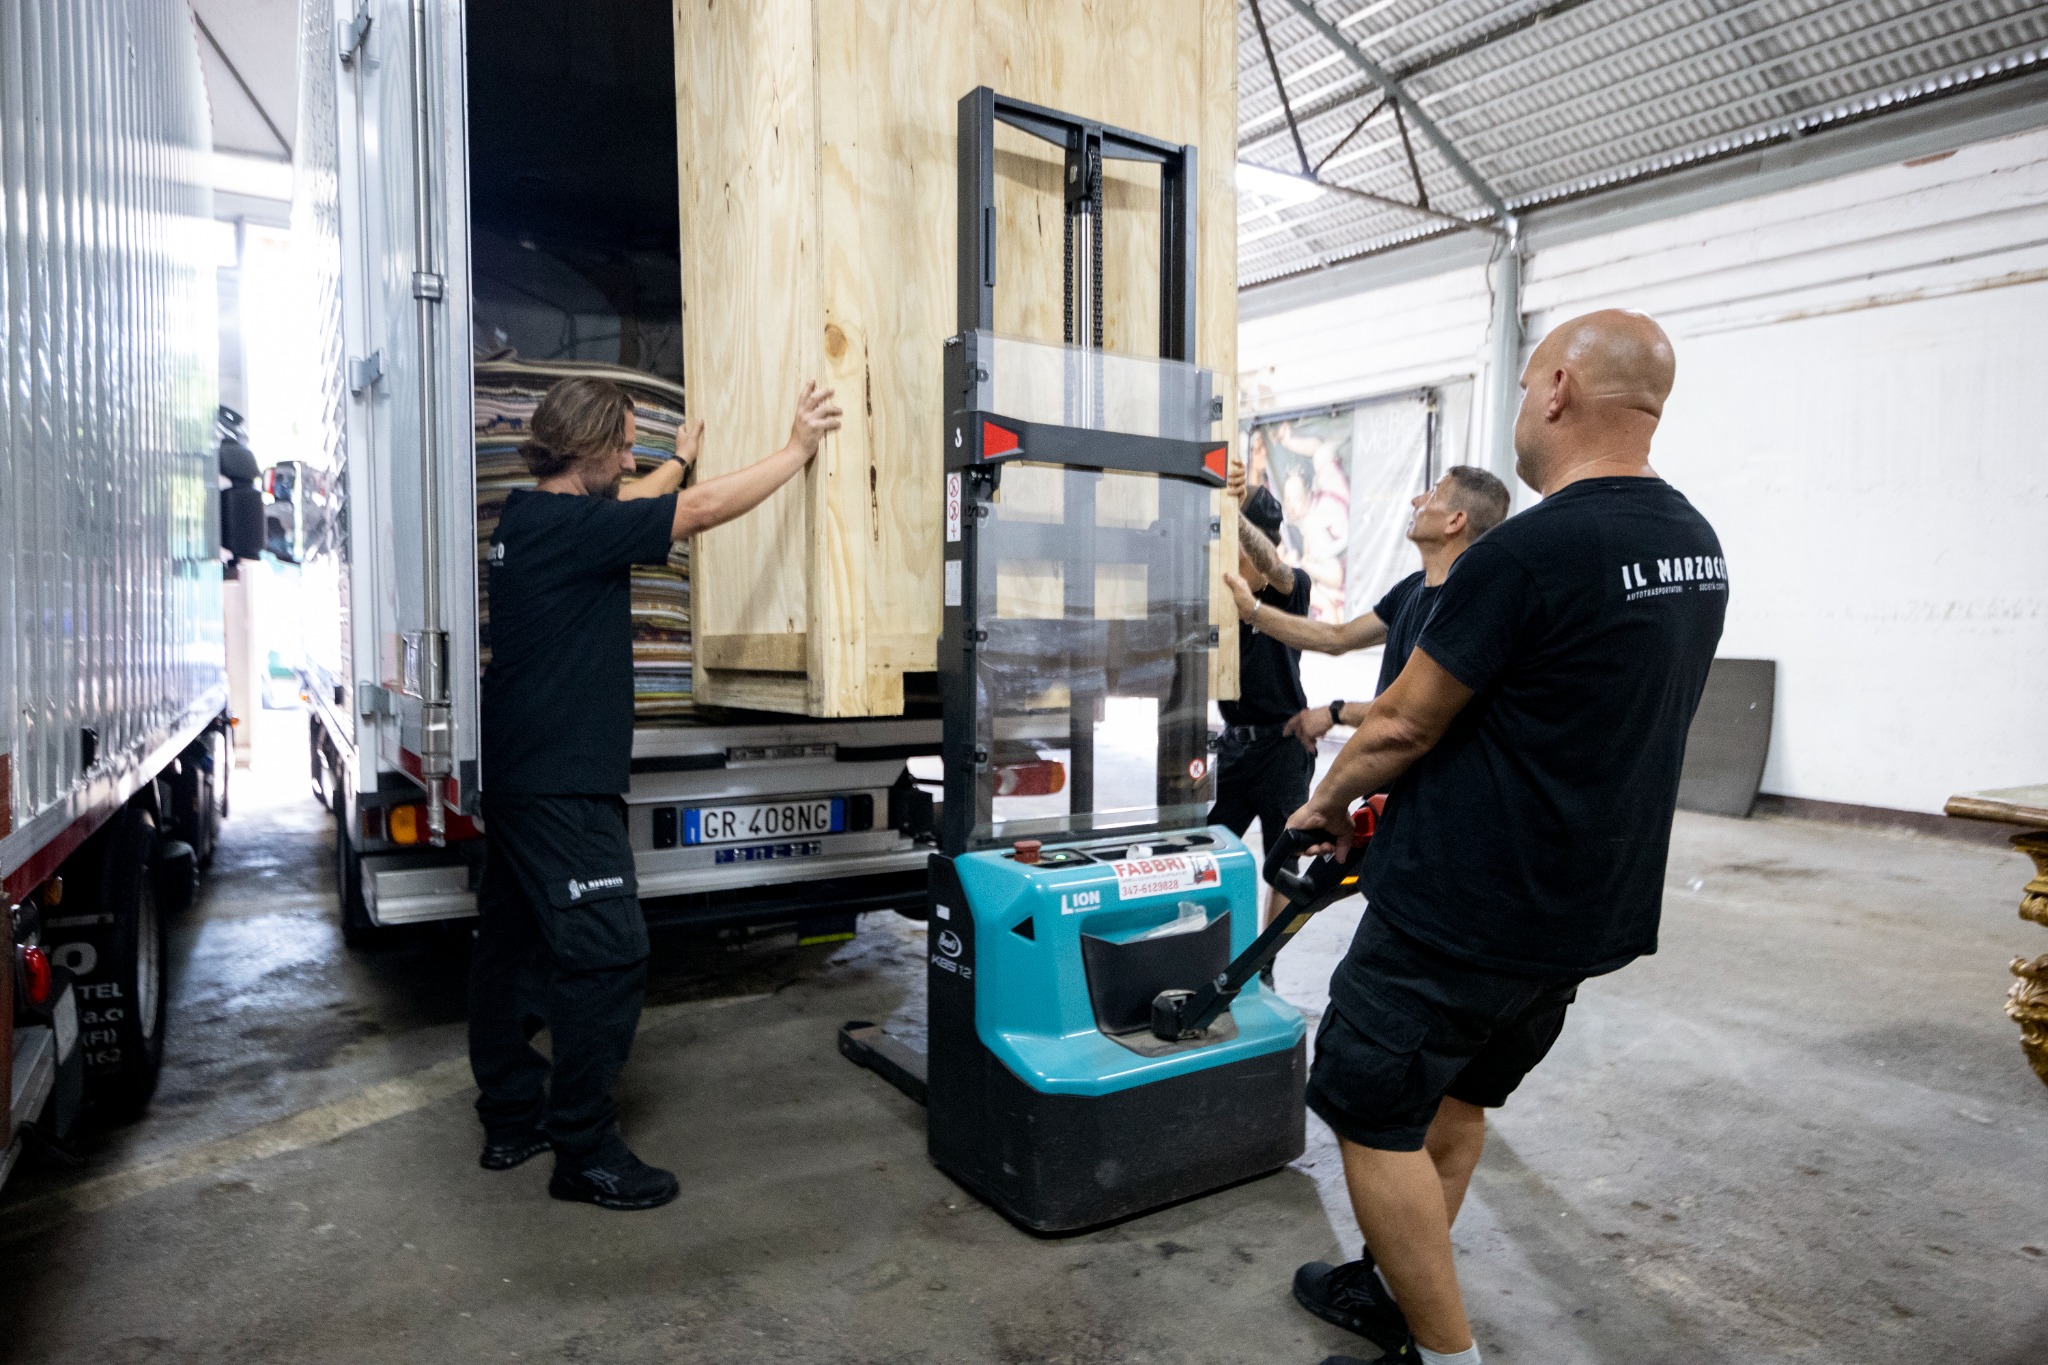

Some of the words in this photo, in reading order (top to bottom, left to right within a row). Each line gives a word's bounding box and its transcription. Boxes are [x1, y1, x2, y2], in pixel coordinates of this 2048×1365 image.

[1622, 563, 1647, 590] IL
[1114, 857, 1186, 877] FABBRI
[1122, 880, 1179, 896] 347-6129828
[1061, 890, 1100, 915] LION
